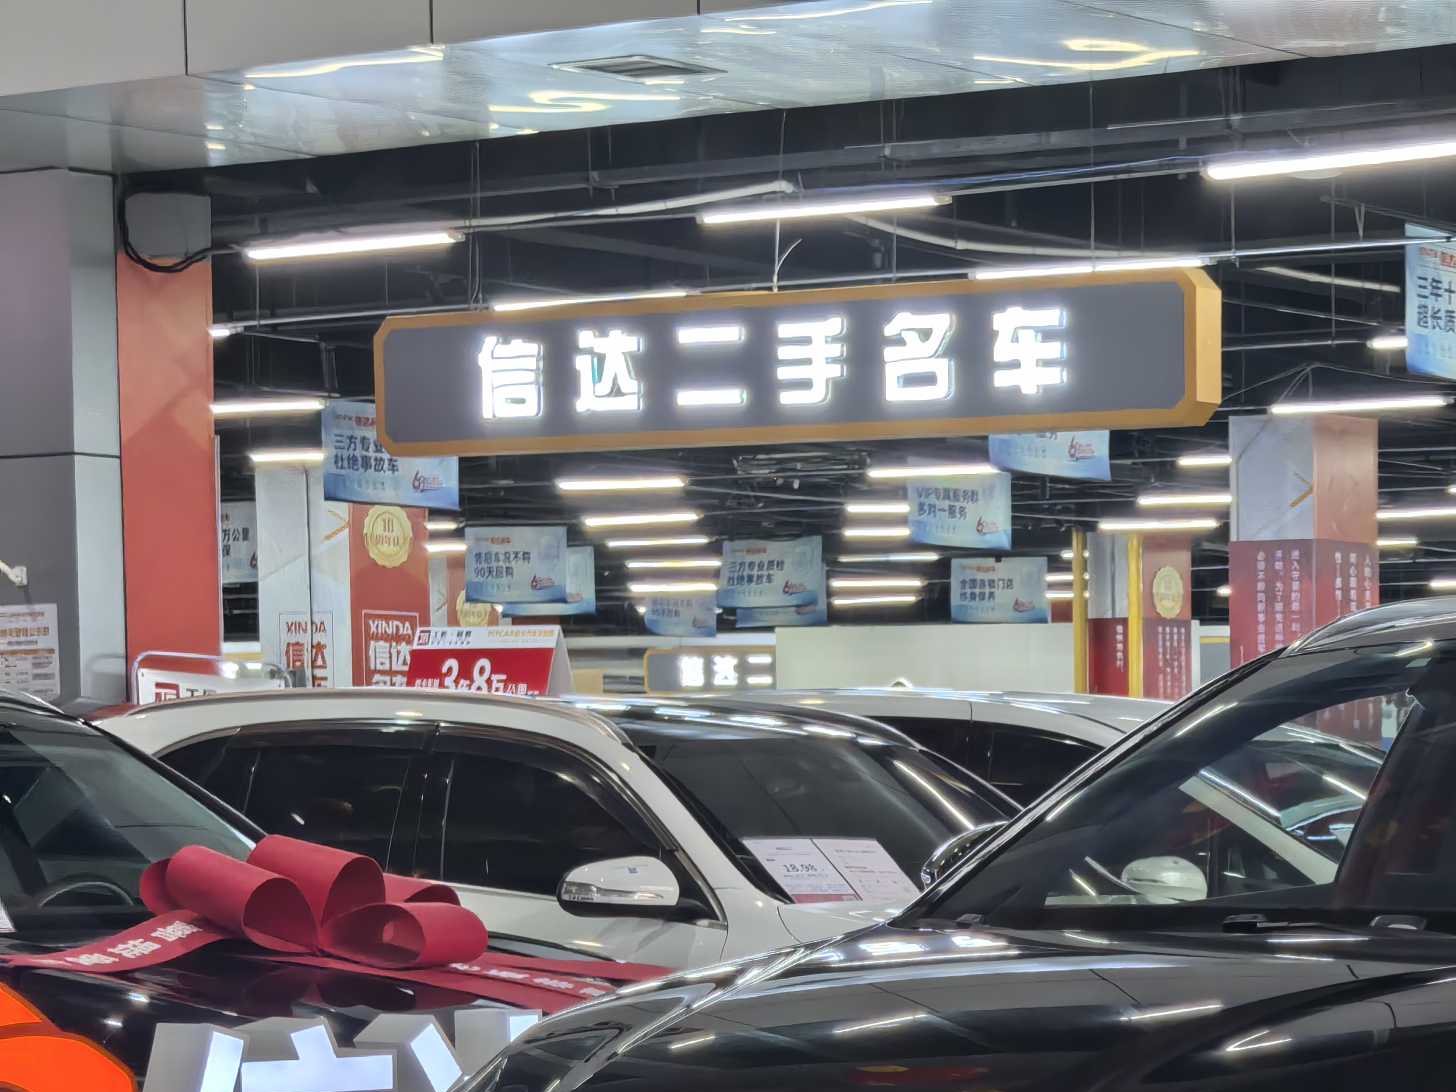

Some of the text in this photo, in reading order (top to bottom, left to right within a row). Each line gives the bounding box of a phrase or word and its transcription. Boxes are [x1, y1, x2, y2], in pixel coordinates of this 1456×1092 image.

[470, 305, 1072, 420] 信达二手名车
[334, 453, 399, 476] 杜绝事故车
[368, 619, 412, 636] XINDA
